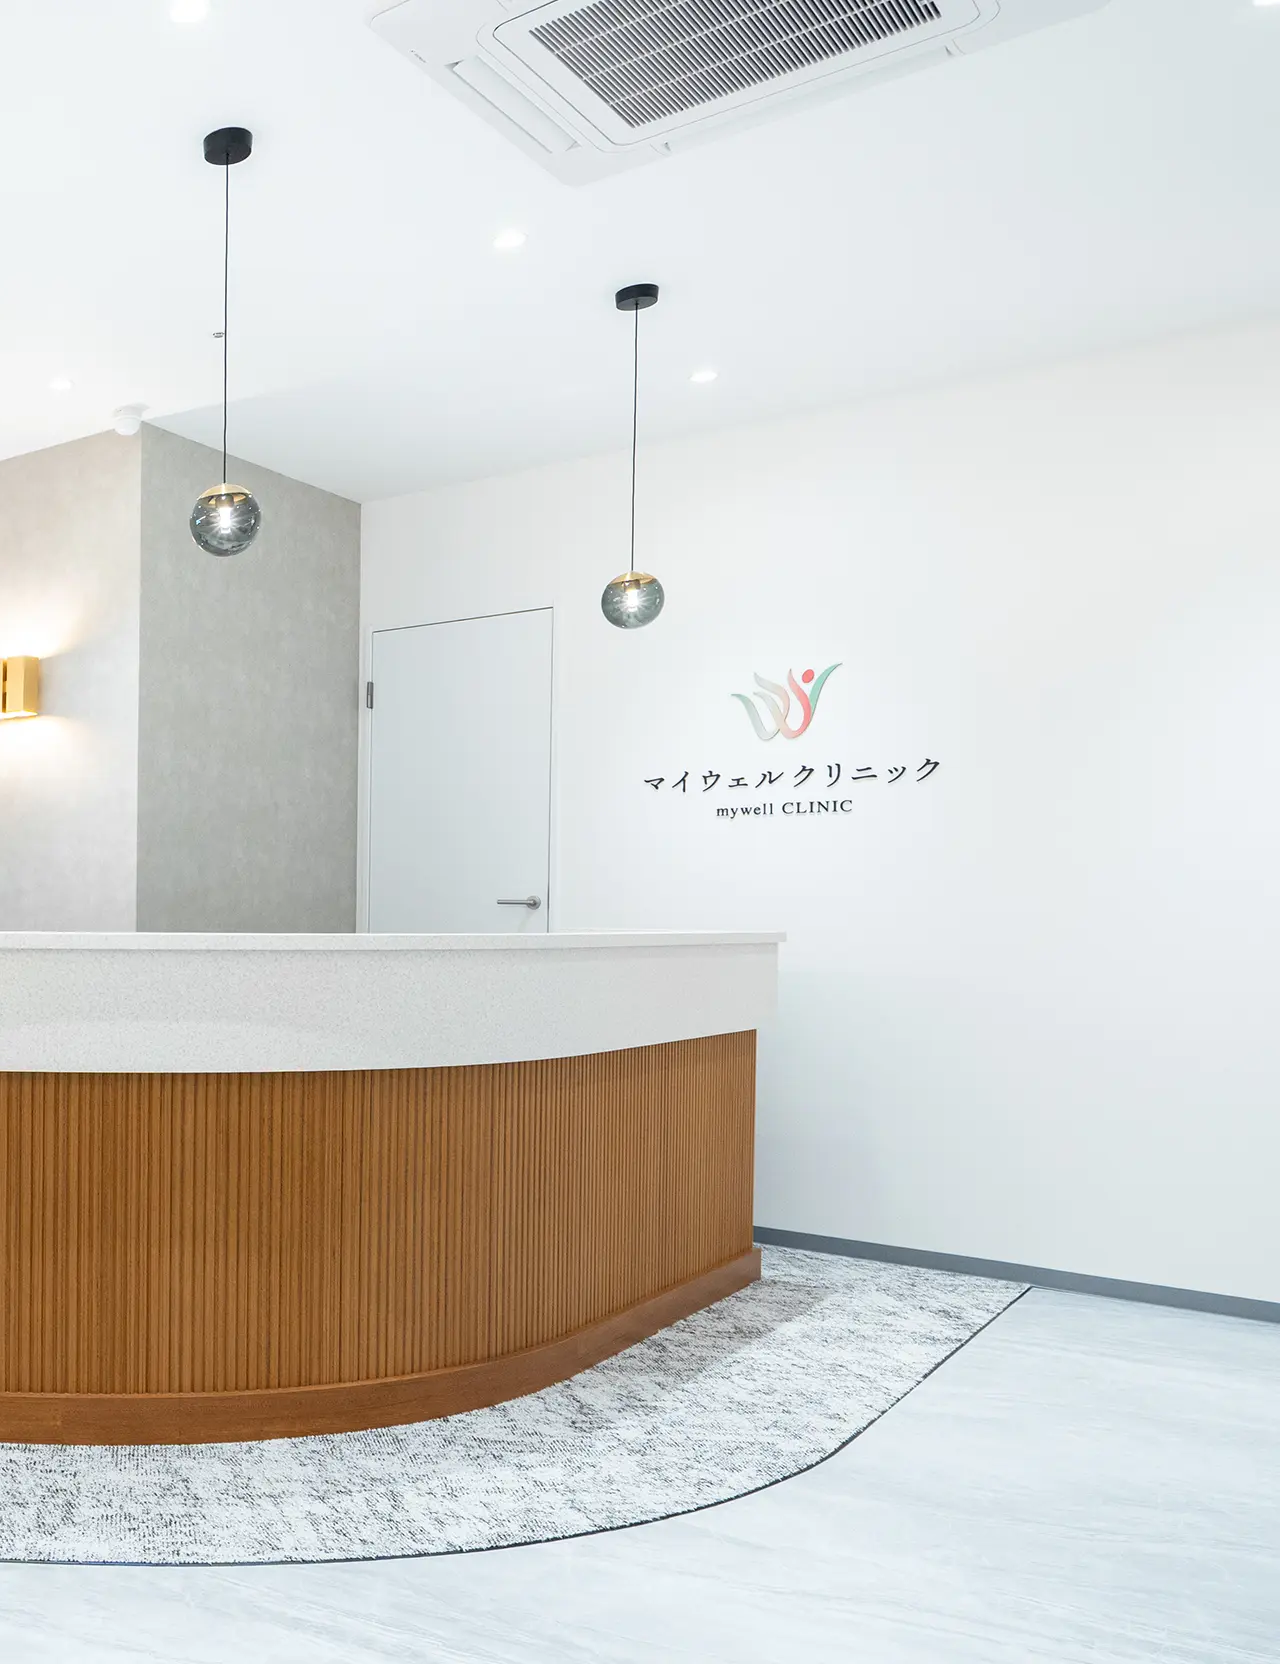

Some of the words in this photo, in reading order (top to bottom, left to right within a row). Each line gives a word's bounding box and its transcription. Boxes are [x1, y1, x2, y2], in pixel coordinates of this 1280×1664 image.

[643, 758, 940, 793] マイウェルクリニック
[716, 802, 774, 820] mywell
[781, 799, 853, 815] CLINIC
